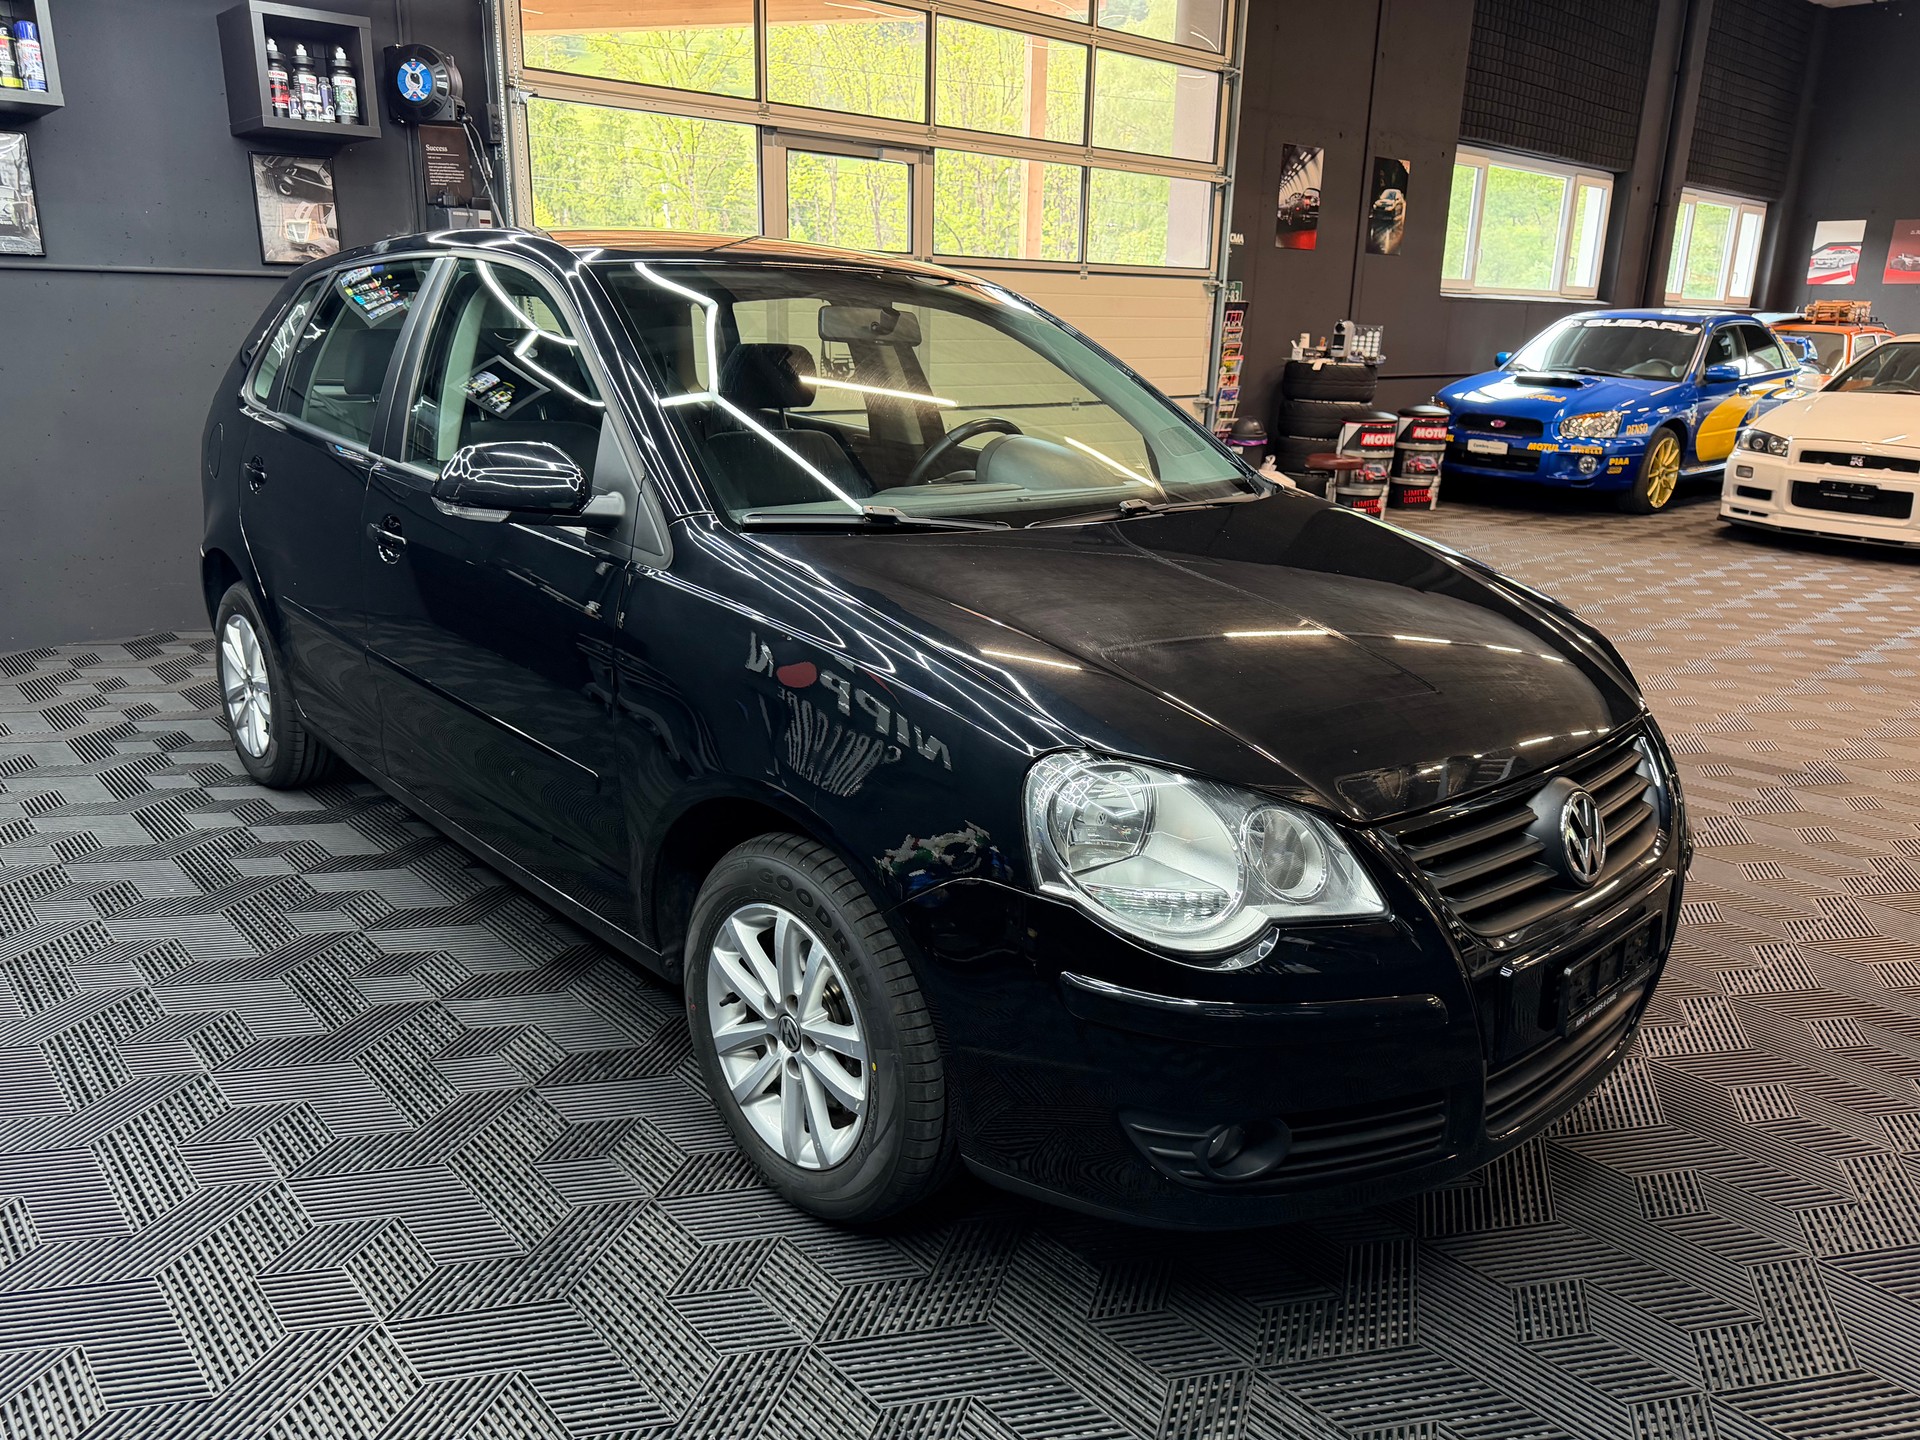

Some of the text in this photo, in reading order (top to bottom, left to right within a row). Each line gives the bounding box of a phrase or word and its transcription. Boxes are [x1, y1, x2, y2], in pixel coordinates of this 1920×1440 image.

[425, 143, 448, 153] Success
[1583, 319, 1702, 335] SUBARU
[1415, 427, 1447, 439] MOTU
[1626, 423, 1648, 436] DENSO
[1362, 433, 1395, 446] MOTU
[1527, 442, 1559, 452] MOTUL
[1609, 457, 1630, 466] PIAA
